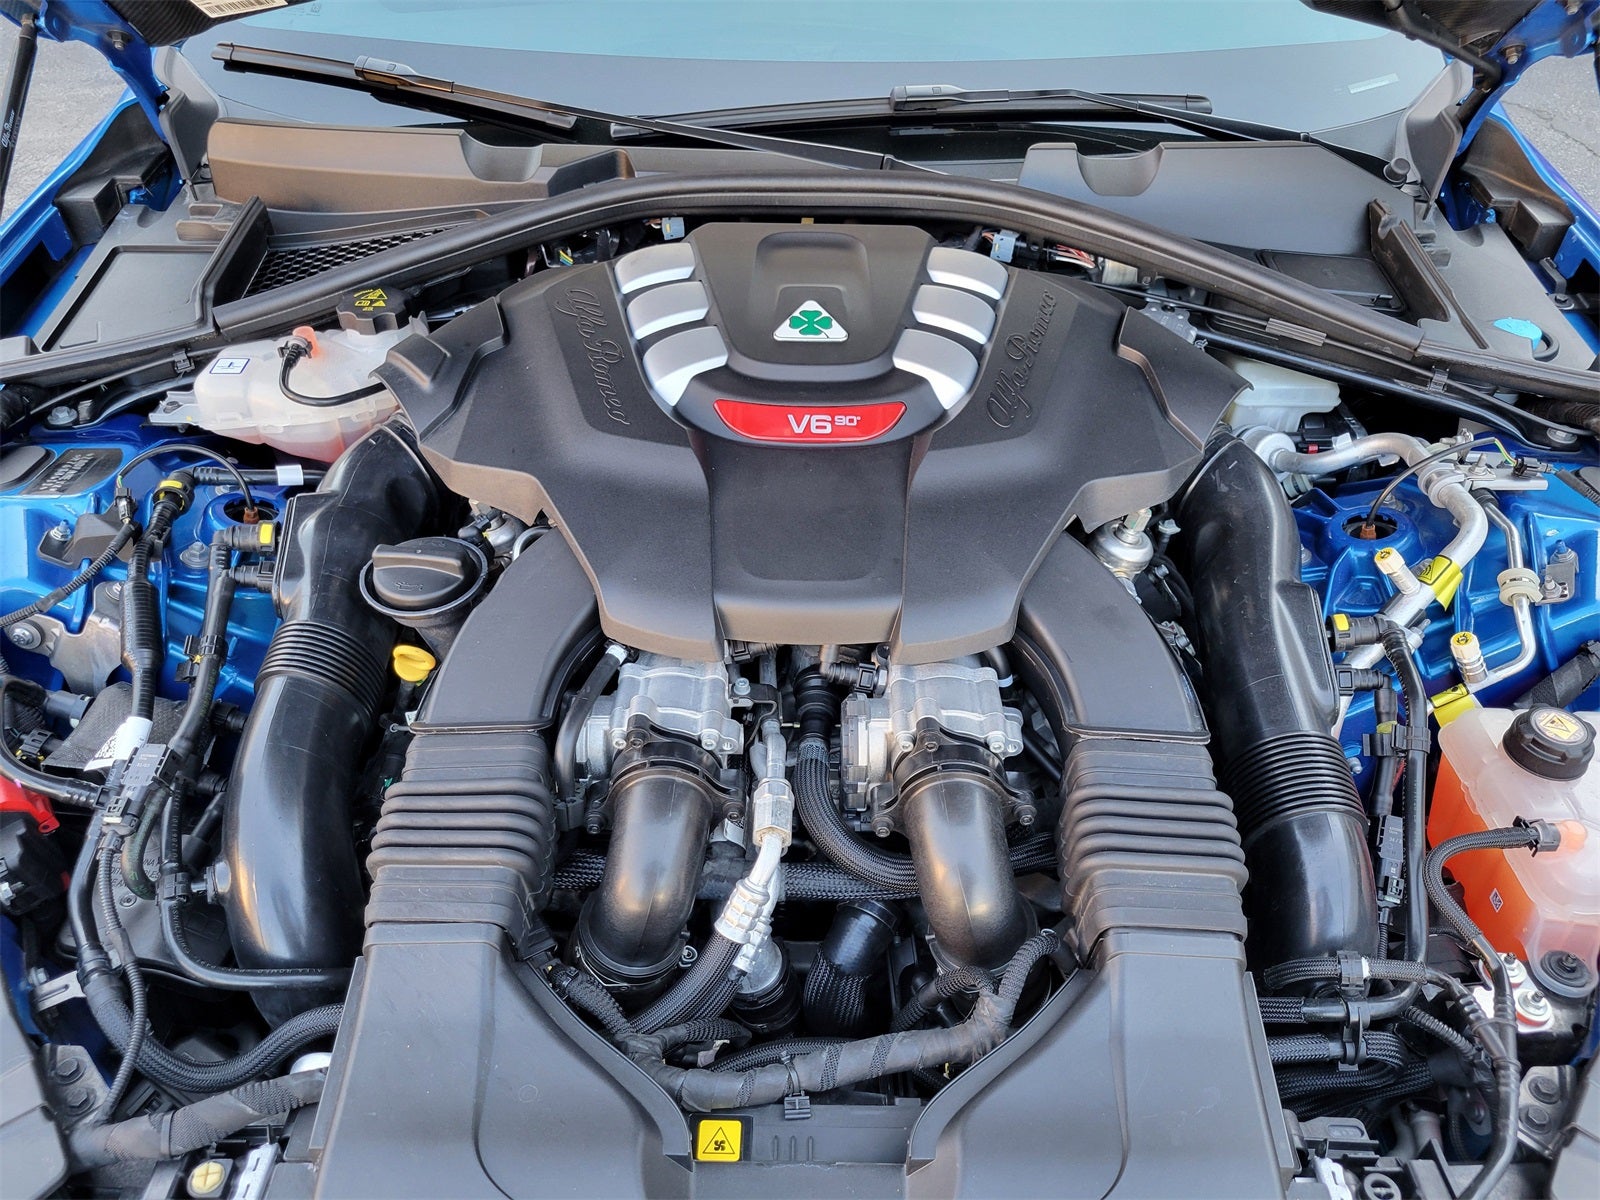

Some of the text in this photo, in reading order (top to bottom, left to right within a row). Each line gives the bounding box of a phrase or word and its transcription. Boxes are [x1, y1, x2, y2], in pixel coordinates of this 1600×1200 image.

[553, 287, 631, 425] Alfa Romeo
[787, 414, 832, 434] V6
[986, 289, 1057, 428] Alfa Romeo
